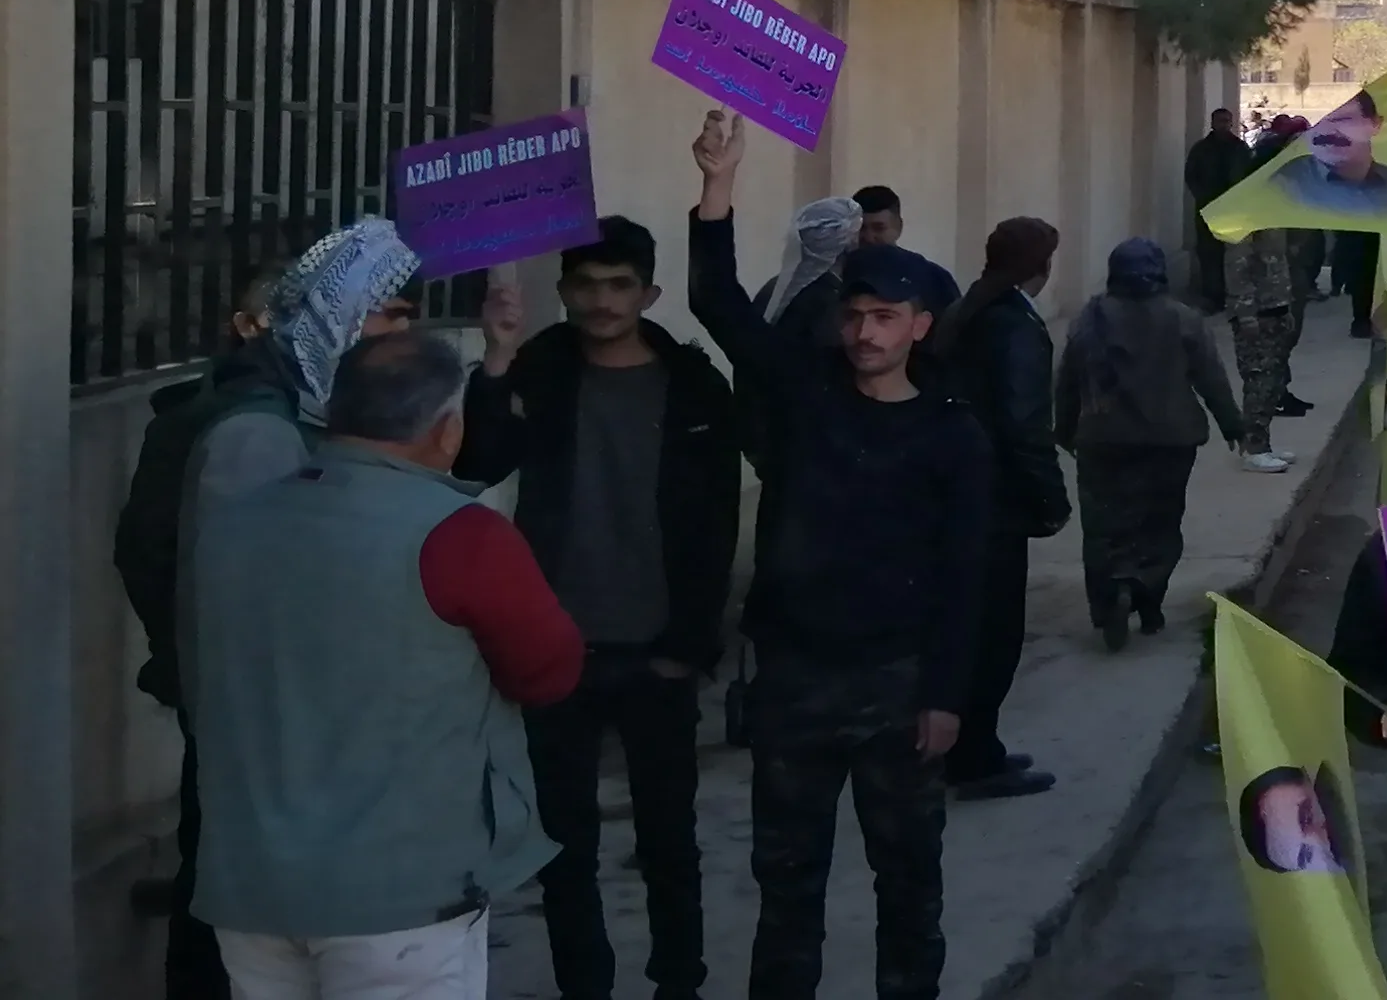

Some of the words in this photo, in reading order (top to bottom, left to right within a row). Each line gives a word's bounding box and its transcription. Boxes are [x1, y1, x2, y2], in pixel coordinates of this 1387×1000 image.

[732, 44, 776, 72] للقائد
[764, 15, 808, 55] RÊBER
[808, 42, 836, 71] APO
[778, 61, 828, 103] الحرية
[406, 151, 451, 187] AZADÎ
[457, 147, 494, 176] JIBO
[497, 135, 545, 166] RÊBER
[551, 126, 580, 153] APO
